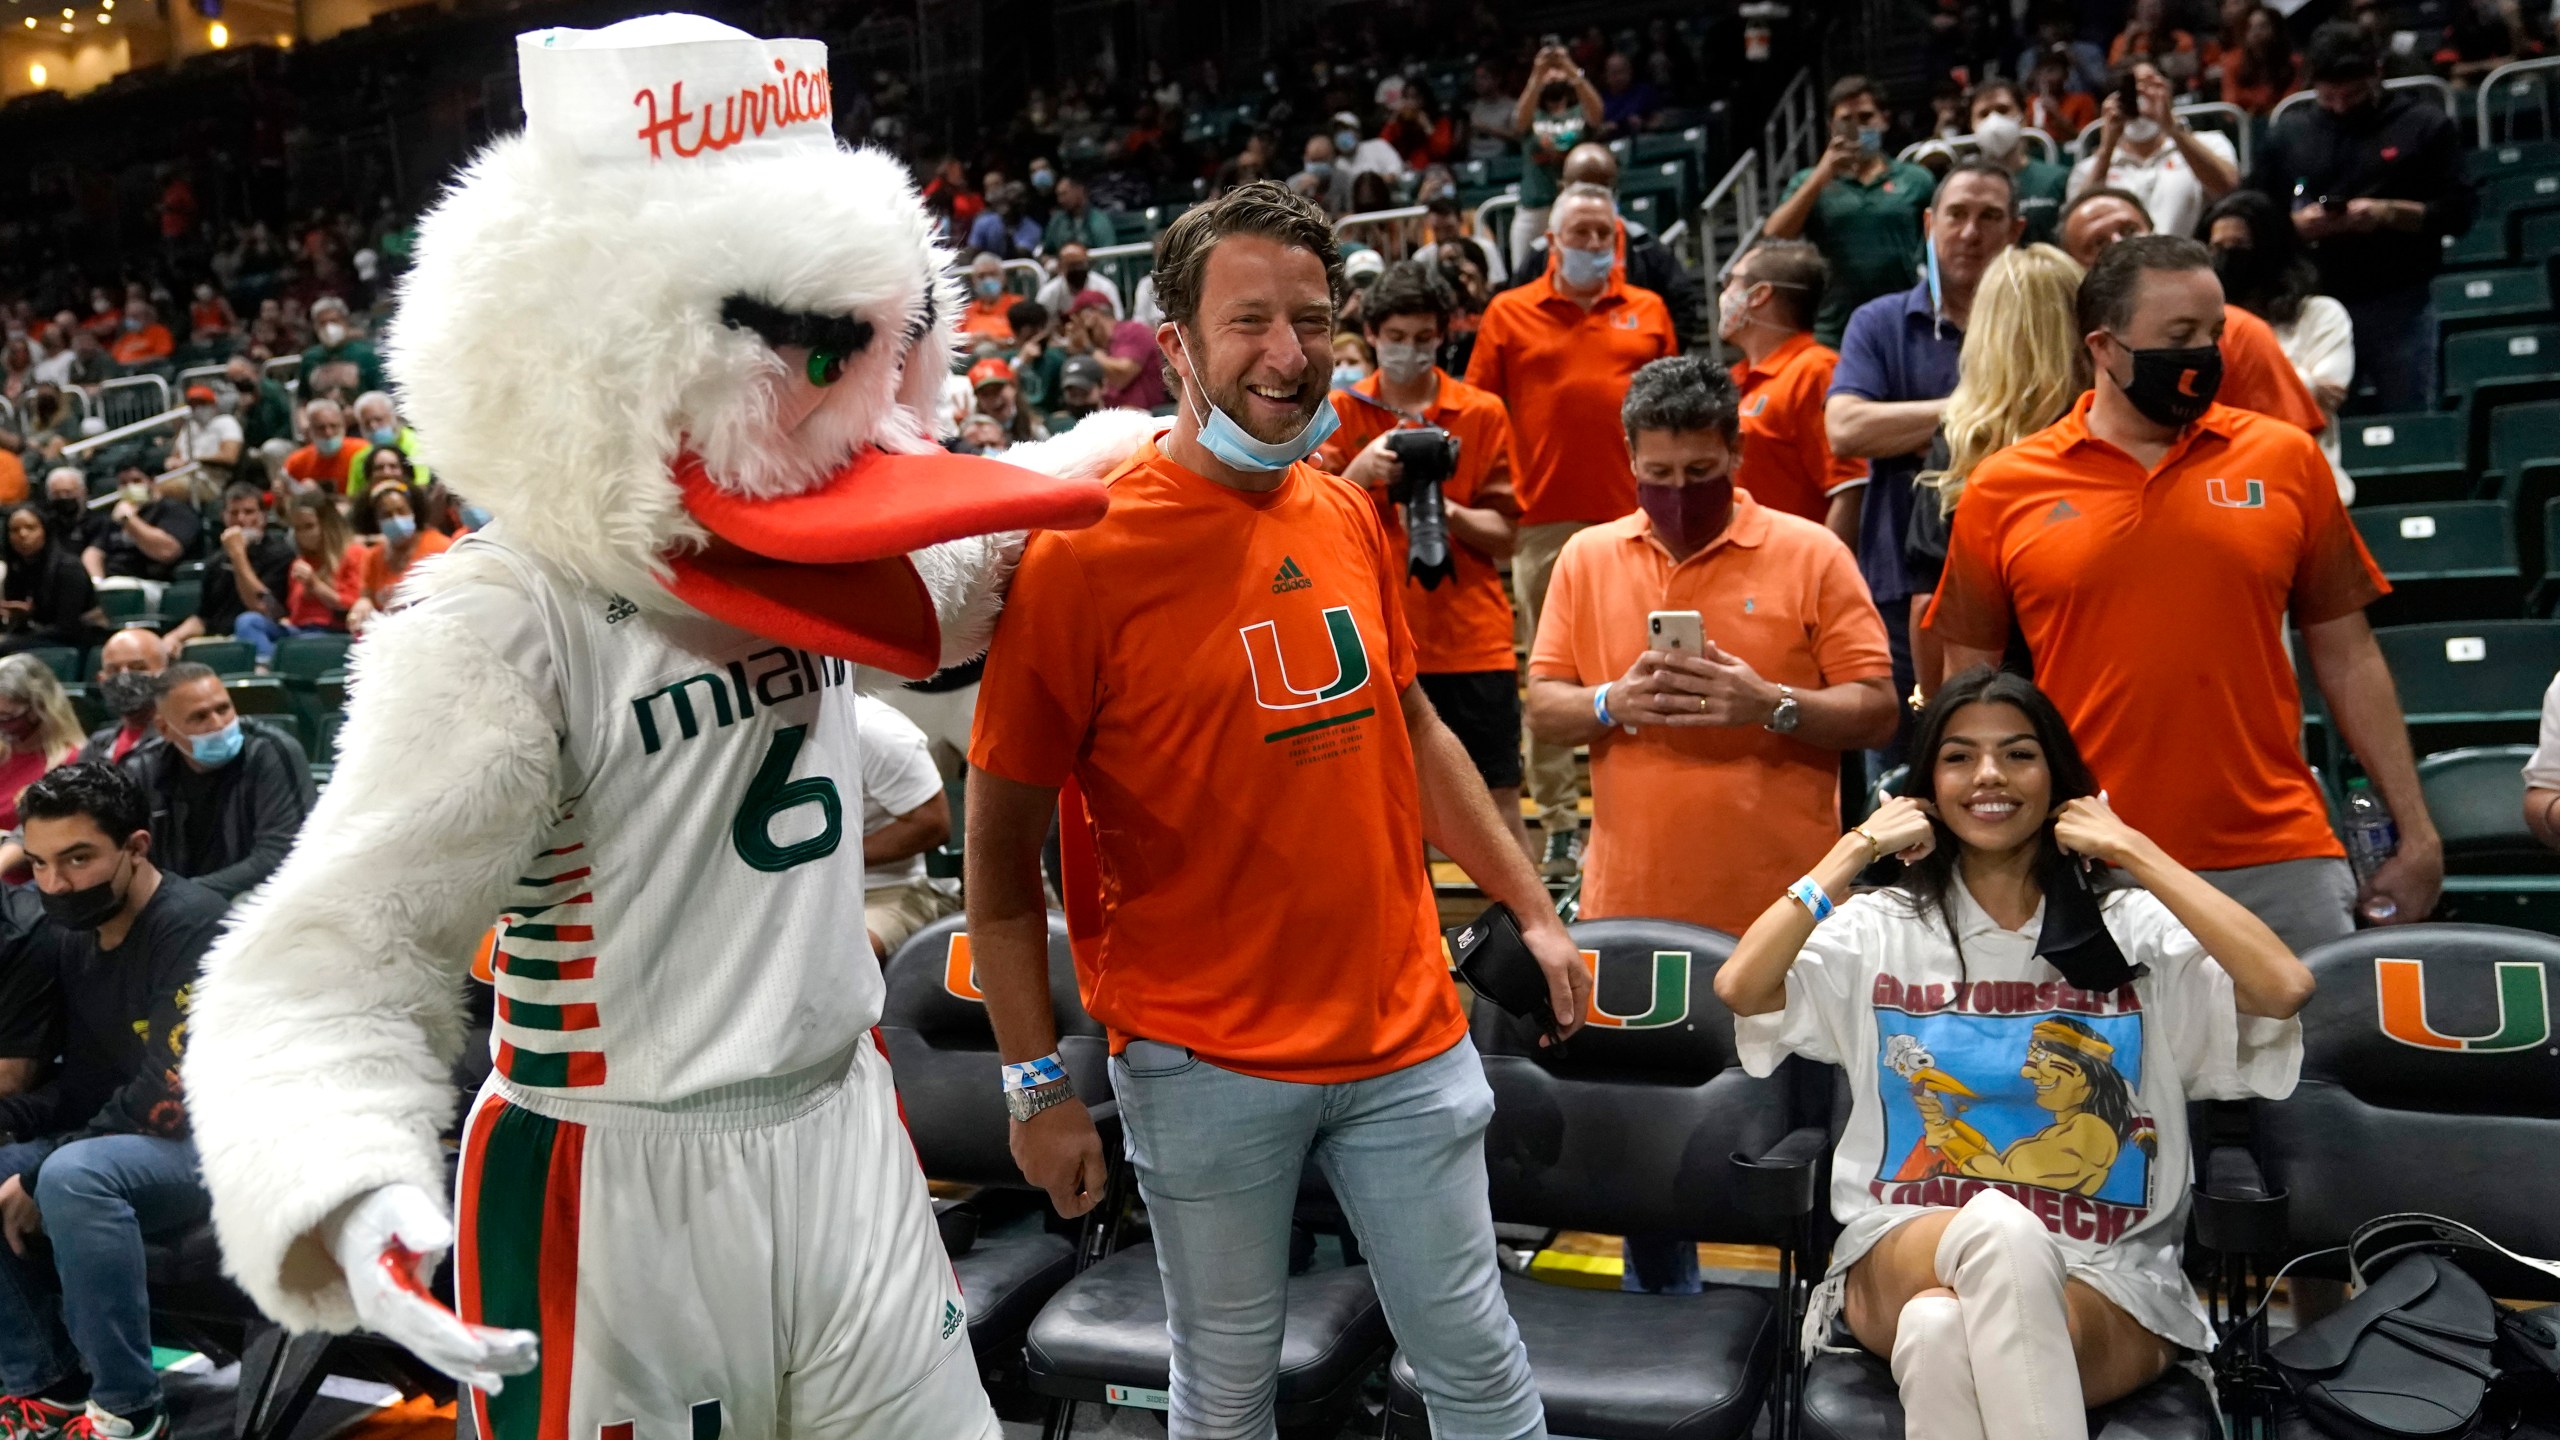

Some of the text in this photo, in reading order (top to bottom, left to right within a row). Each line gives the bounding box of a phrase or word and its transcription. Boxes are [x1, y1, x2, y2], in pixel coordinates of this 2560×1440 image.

[633, 58, 832, 159] Hurrican
[2206, 478, 2265, 508] U
[1271, 577, 1312, 594] adidas
[1239, 605, 1370, 710] U
[733, 723, 842, 872] 6
[1578, 949, 1692, 1030] U
[1872, 972, 1946, 1012] GRAB
[2374, 957, 2552, 1054] U
